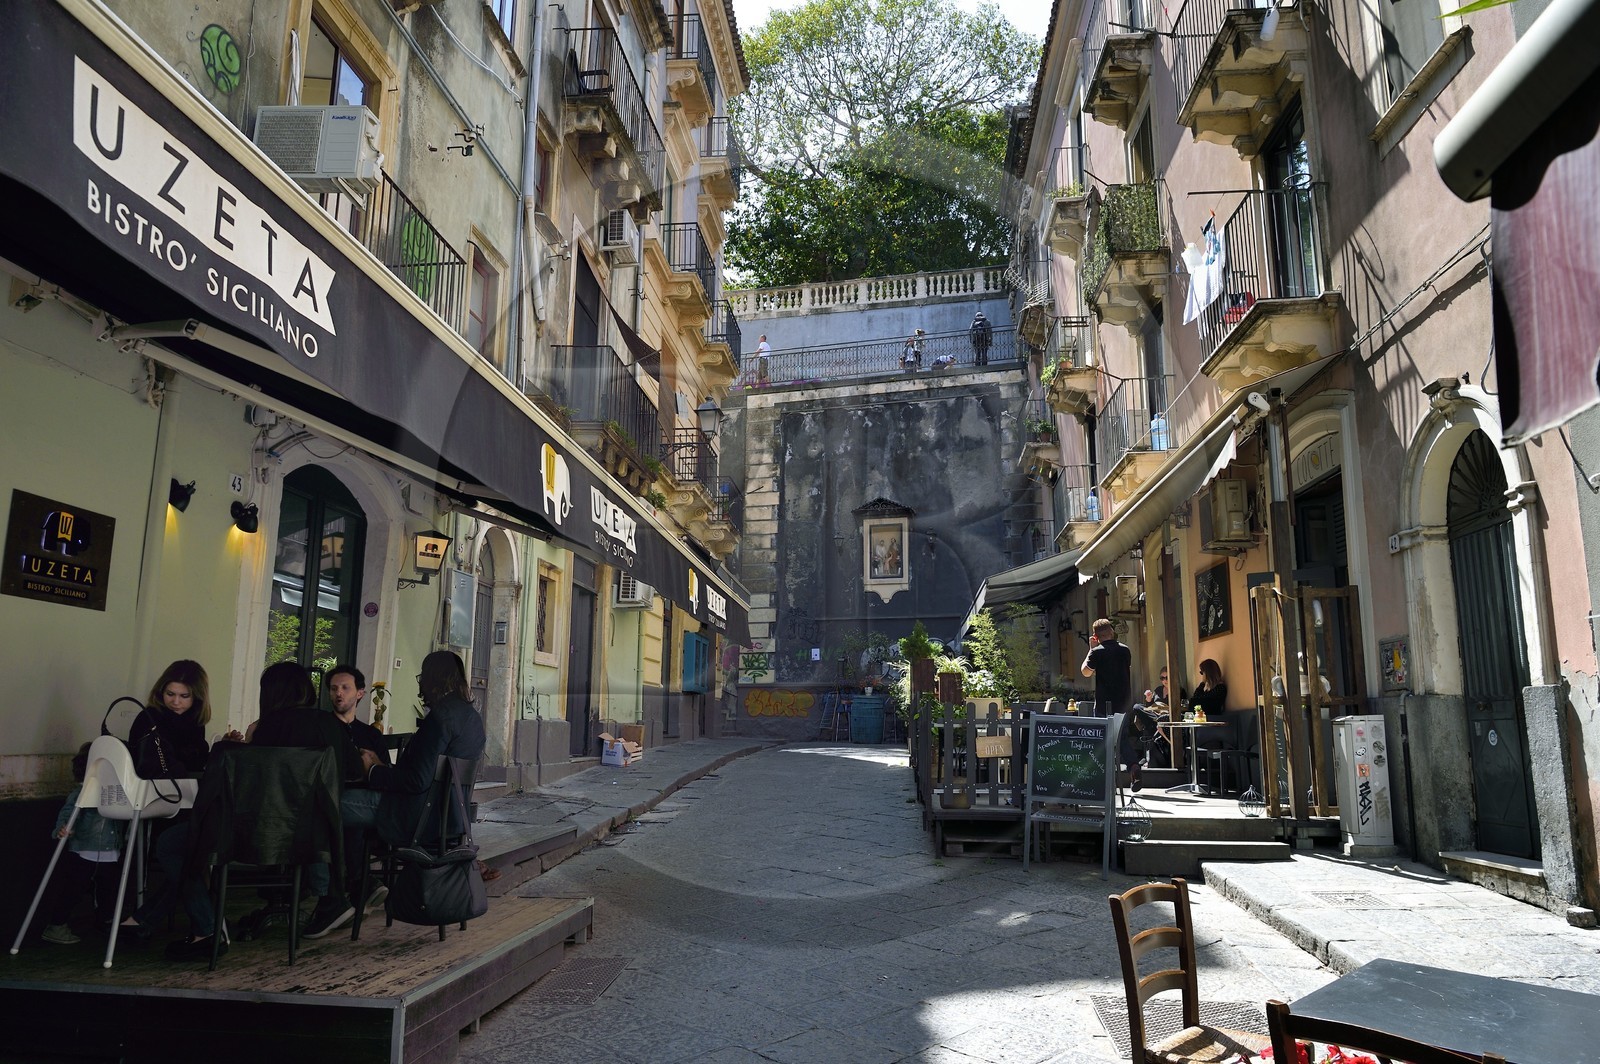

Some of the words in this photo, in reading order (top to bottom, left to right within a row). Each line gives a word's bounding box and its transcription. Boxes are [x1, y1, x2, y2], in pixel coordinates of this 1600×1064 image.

[90, 83, 320, 314] UZETA
[86, 179, 198, 273] BISTRO'
[206, 267, 319, 359] SICILIANO
[231, 476, 242, 492] 43
[61, 515, 73, 536] UZ
[31, 557, 93, 584] UZETA
[27, 582, 53, 593] BISTRO'
[54, 587, 87, 599] SICILIANO
[1037, 724, 1059, 735] Wine
[1061, 726, 1075, 735] Bar
[985, 744, 1005, 755] OPEN
